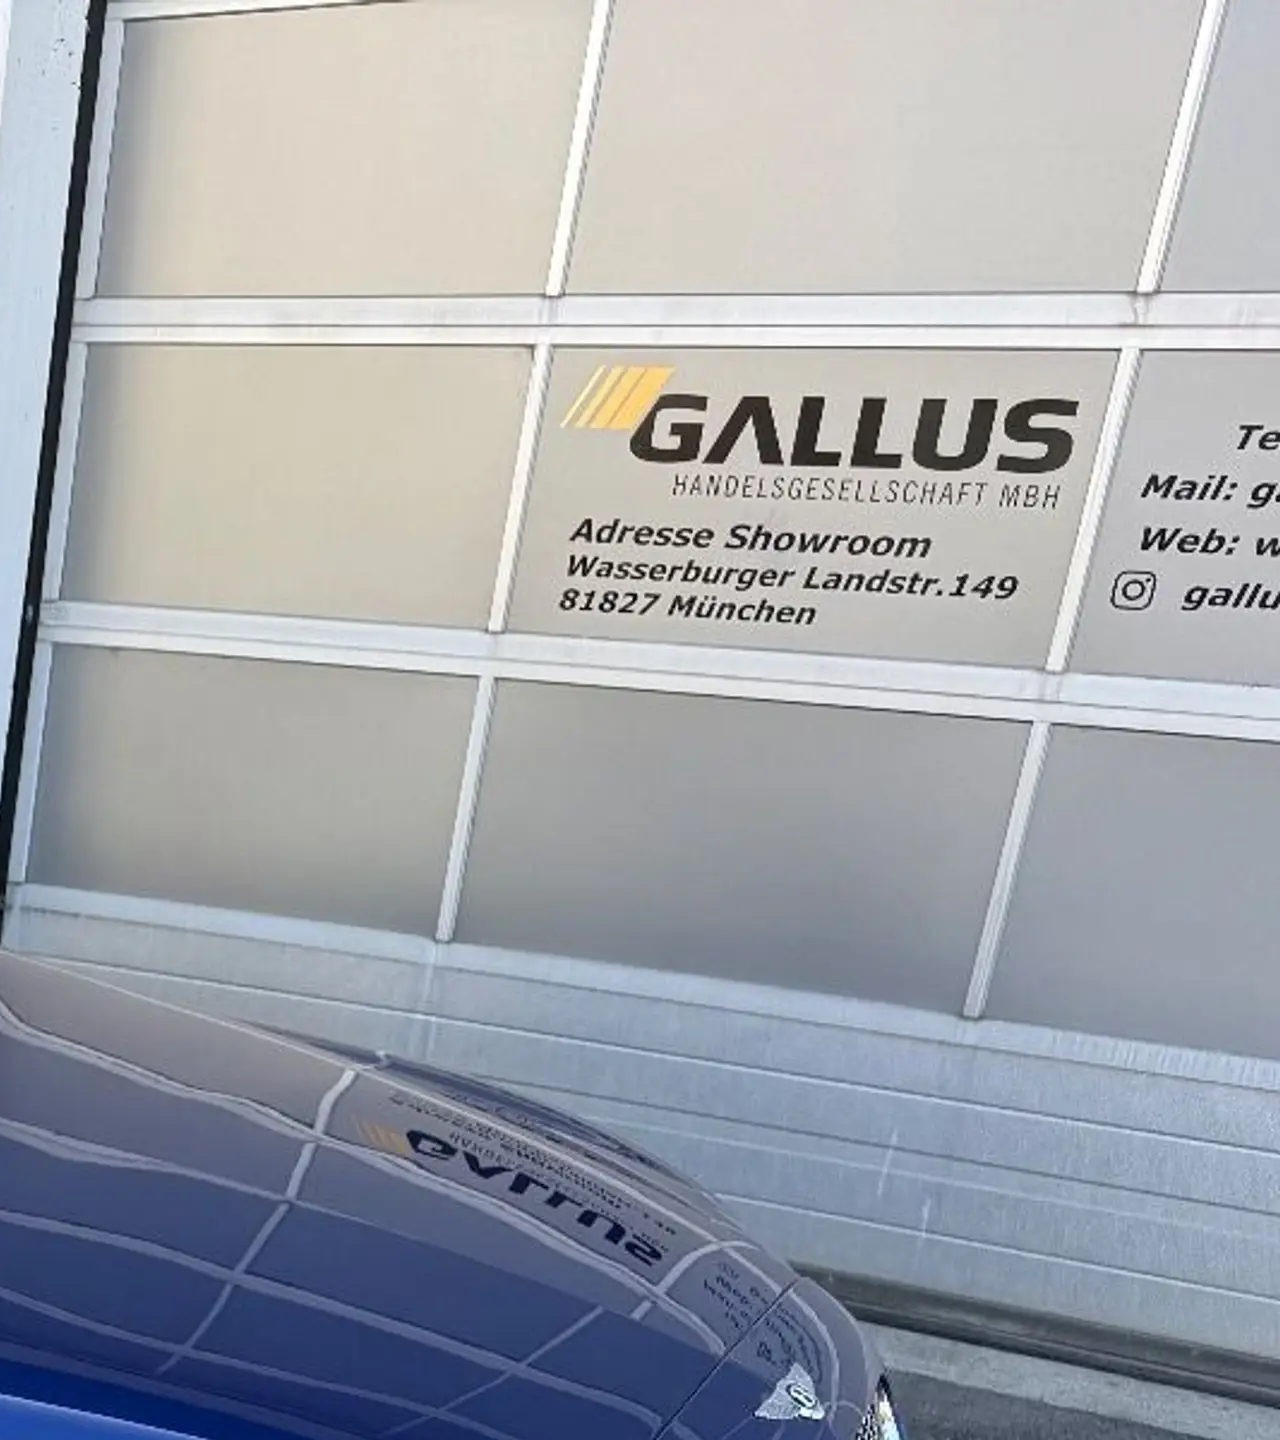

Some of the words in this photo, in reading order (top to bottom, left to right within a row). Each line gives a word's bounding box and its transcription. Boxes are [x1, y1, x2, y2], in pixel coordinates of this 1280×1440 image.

[629, 394, 1080, 473] GALLUS
[671, 473, 988, 507] HANDELSGESELLSCHAFT
[998, 484, 1061, 510] MBH
[1141, 473, 1238, 501] Mail:
[569, 518, 715, 549] Adresse
[724, 523, 932, 558] Showroom
[1141, 526, 1240, 556] Web:
[567, 554, 796, 591] Wasserburger
[802, 566, 1019, 600] Landstr.149
[559, 588, 661, 615] 81827
[668, 594, 817, 625] München
